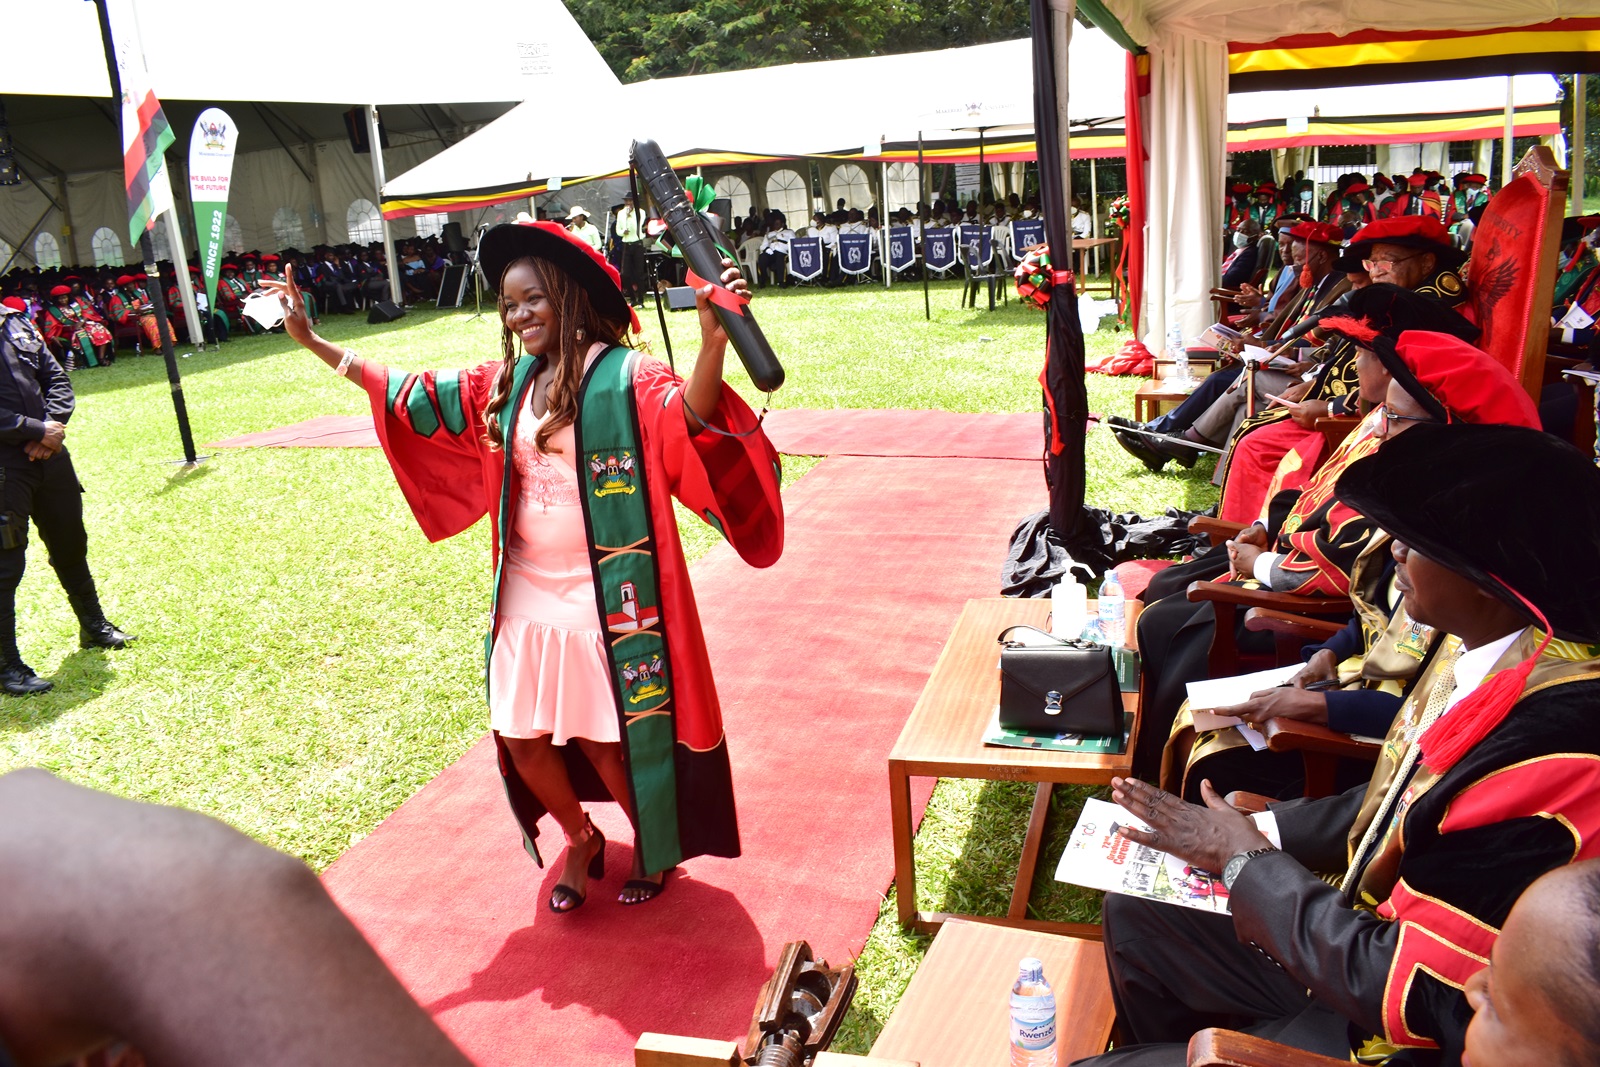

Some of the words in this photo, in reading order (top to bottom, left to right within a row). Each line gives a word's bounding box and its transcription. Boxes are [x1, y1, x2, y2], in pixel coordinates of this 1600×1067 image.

[210, 210, 222, 240] 1922
[205, 241, 219, 278] SINCE
[1106, 831, 1122, 860] Graduati
